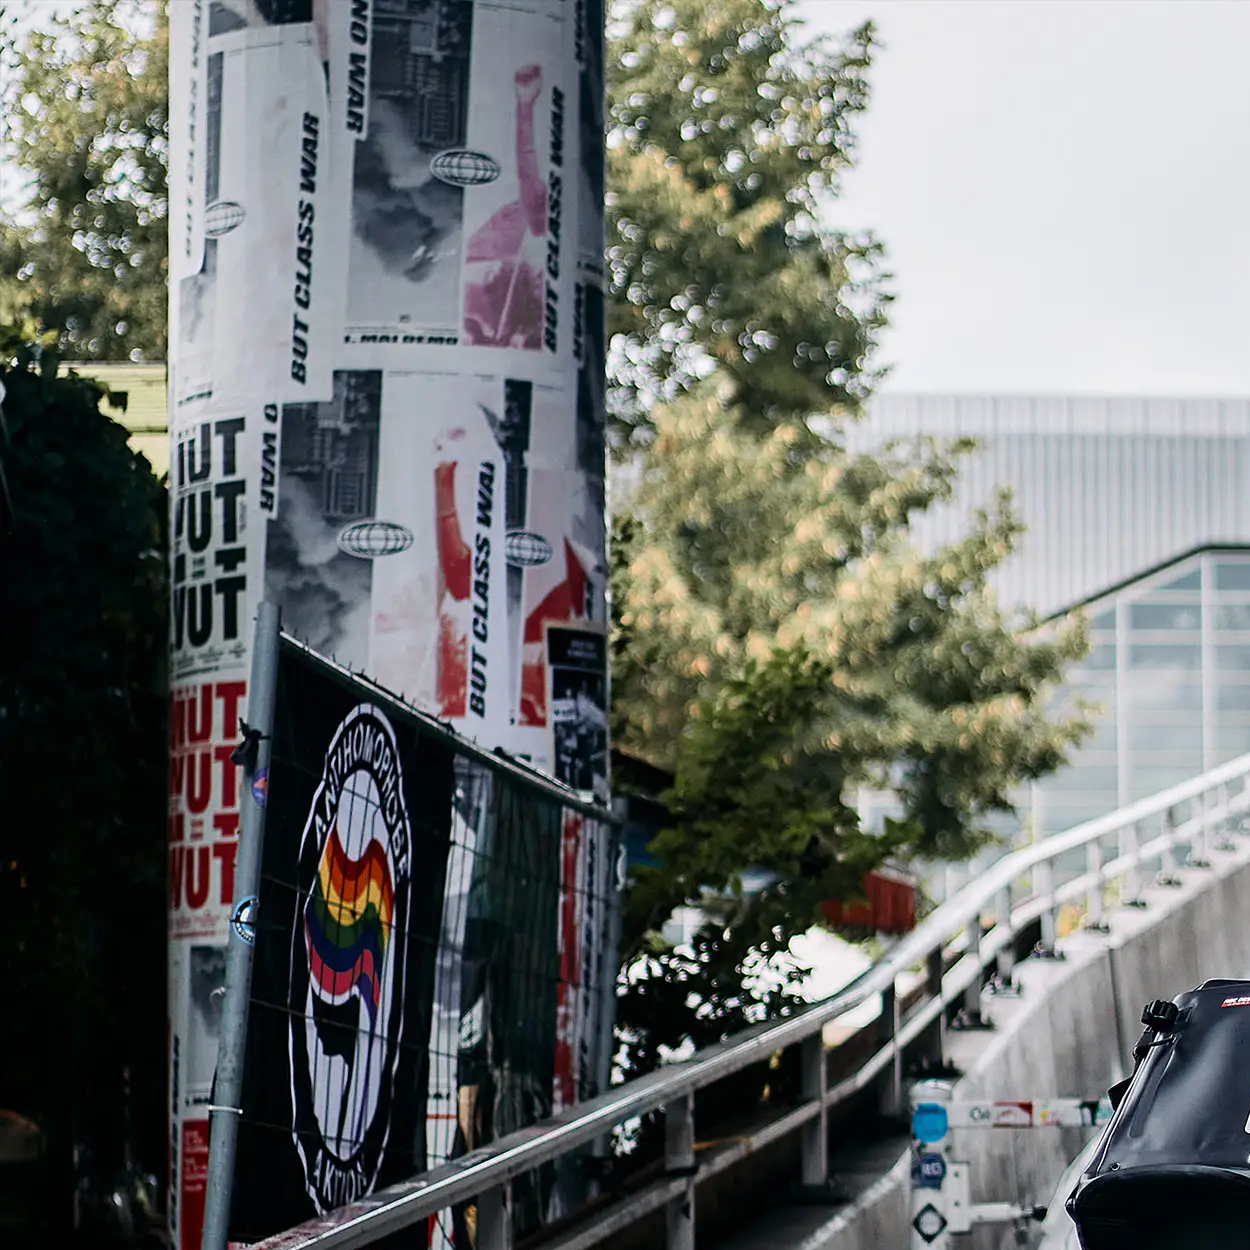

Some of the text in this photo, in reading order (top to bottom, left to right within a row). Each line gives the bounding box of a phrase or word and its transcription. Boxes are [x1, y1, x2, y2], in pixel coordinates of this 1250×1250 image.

[346, 53, 366, 134] WAR
[291, 112, 319, 385] BUT CLASS WAR
[260, 432, 277, 513] WAR
[472, 532, 491, 643] CLASS
[470, 644, 488, 719] BUT
